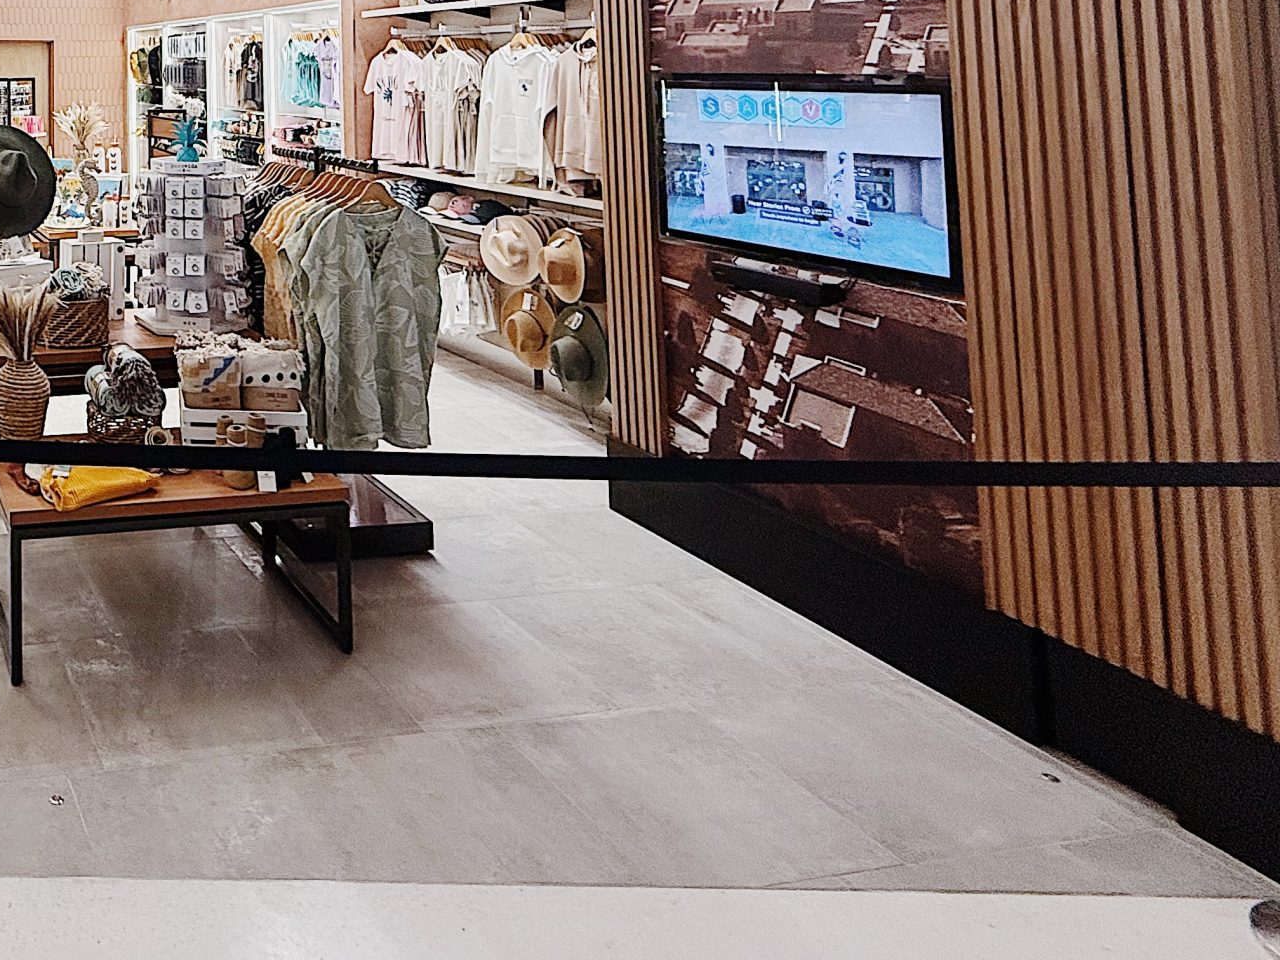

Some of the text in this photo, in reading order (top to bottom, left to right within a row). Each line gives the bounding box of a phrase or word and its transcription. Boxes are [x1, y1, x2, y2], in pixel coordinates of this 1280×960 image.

[706, 100, 753, 114] SEA
[762, 201, 784, 210] Stories
[784, 204, 801, 213] From
